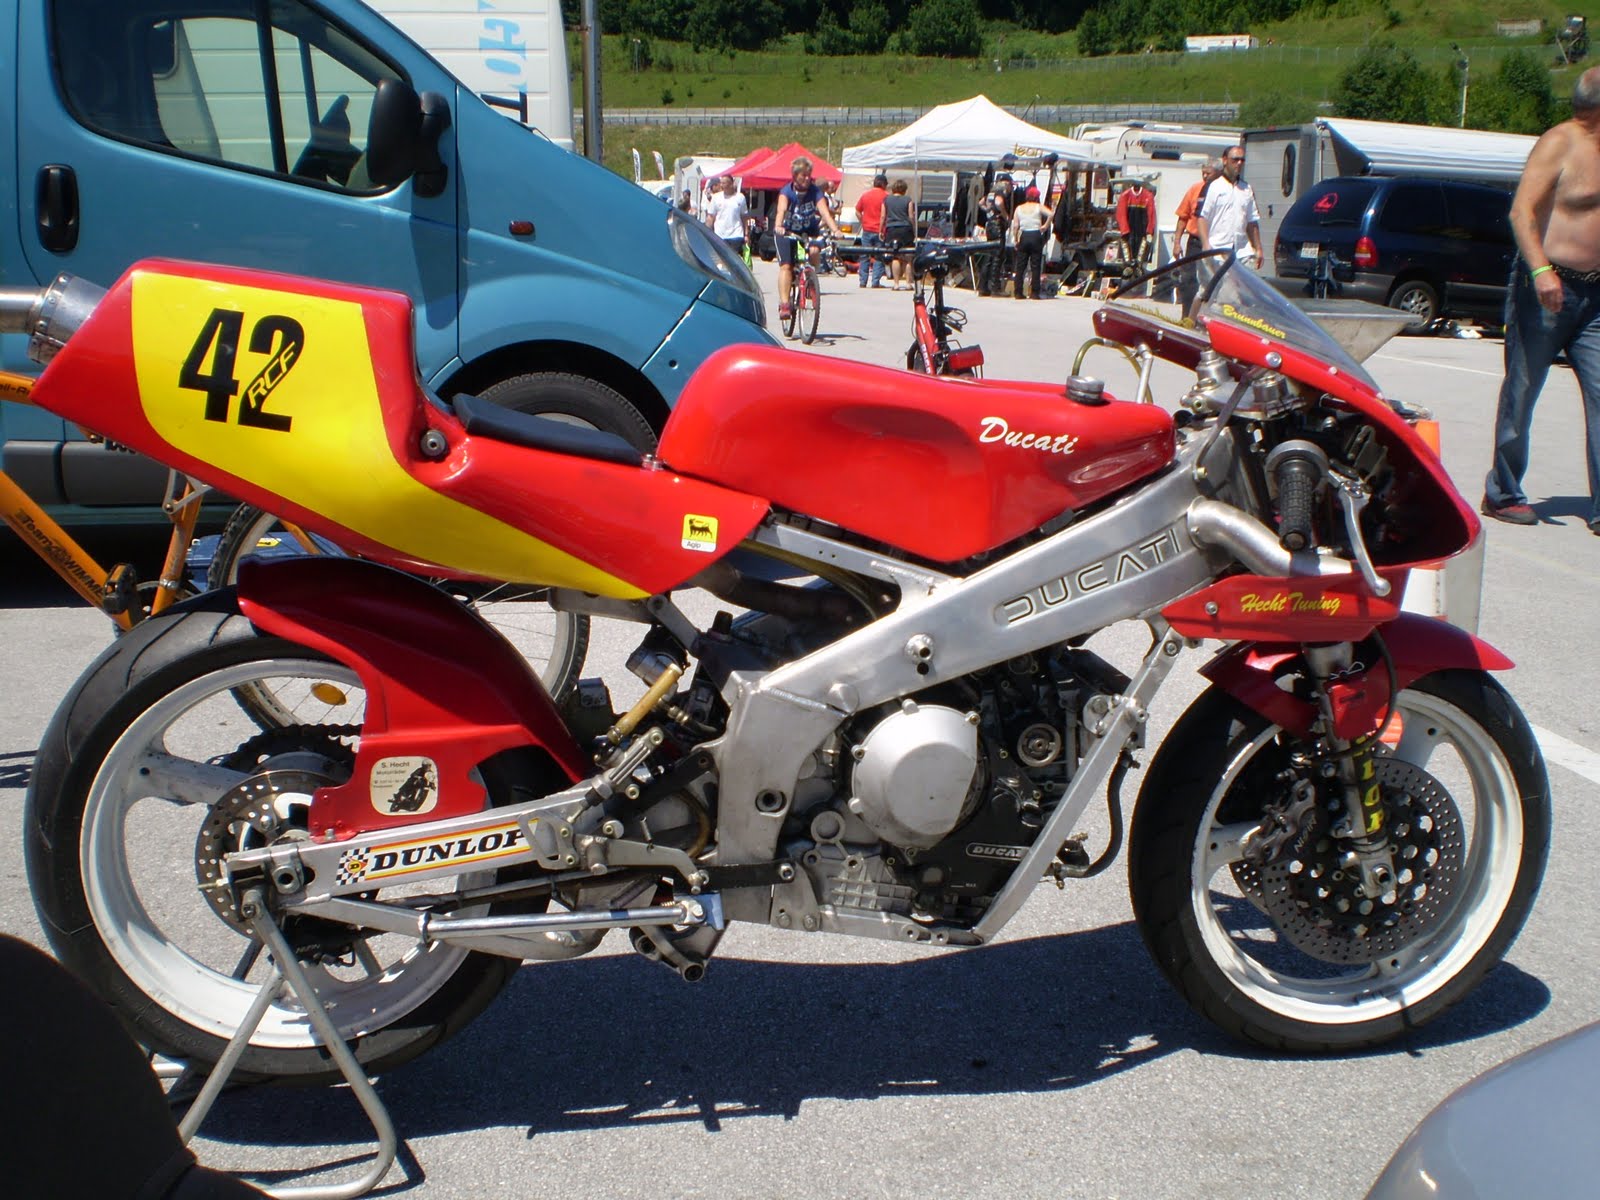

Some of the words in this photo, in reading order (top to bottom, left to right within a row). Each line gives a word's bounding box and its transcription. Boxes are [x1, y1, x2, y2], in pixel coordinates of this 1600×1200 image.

[178, 307, 305, 433] 42
[247, 341, 297, 409] RCF
[979, 416, 1079, 455] Ducati
[1002, 527, 1181, 628] DUCATI
[1240, 592, 1287, 613] Hecht
[1288, 591, 1341, 616] Tuning
